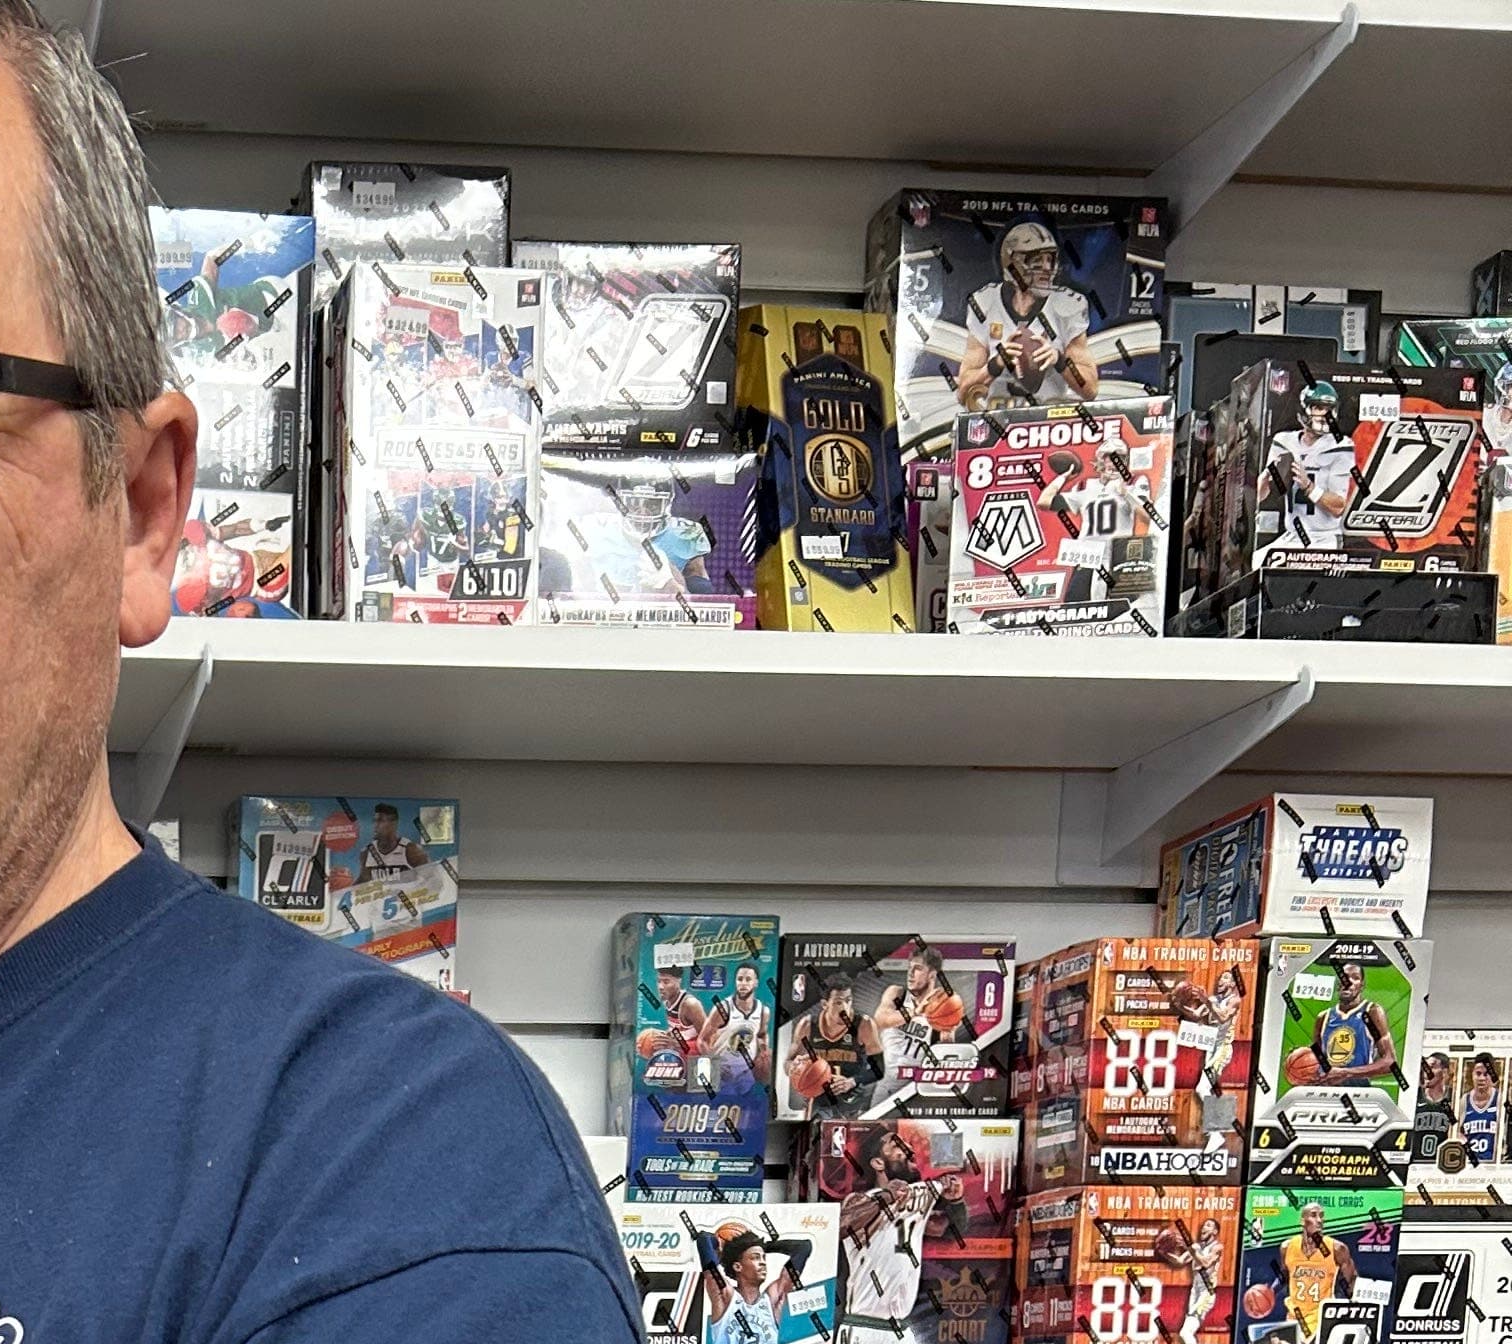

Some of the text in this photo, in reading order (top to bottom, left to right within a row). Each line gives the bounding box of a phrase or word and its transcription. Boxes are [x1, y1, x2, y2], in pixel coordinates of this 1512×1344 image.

[962, 200, 1110, 215] 2019 NFL TRAING CARDS
[1130, 271, 1155, 299] 12
[802, 398, 865, 433] GOLD
[1007, 420, 1122, 449] CHOICE
[810, 505, 876, 526] STANDARD
[1349, 514, 1425, 526] FOOTBALL
[1382, 559, 1413, 570] PANINI
[1300, 836, 1408, 871] THREADS
[1122, 948, 1253, 963] NBA TRADING CARDS
[1335, 945, 1375, 954] 2018-19
[1105, 1029, 1177, 1097] 88
[1102, 1096, 1175, 1111] NBA CARDS!
[663, 1104, 740, 1134] 2019-20
[1290, 1110, 1382, 1125] PRIZM
[1300, 1154, 1371, 1167] AUTOGRAPH
[1107, 1196, 1235, 1211] NBA TRADING CARDS
[1338, 1195, 1364, 1208] CARDS
[1090, 1276, 1163, 1342] 88
[1324, 1306, 1376, 1320] OPTIC
[939, 1319, 988, 1343] COURT
[1395, 1319, 1461, 1333] DONRUSS
